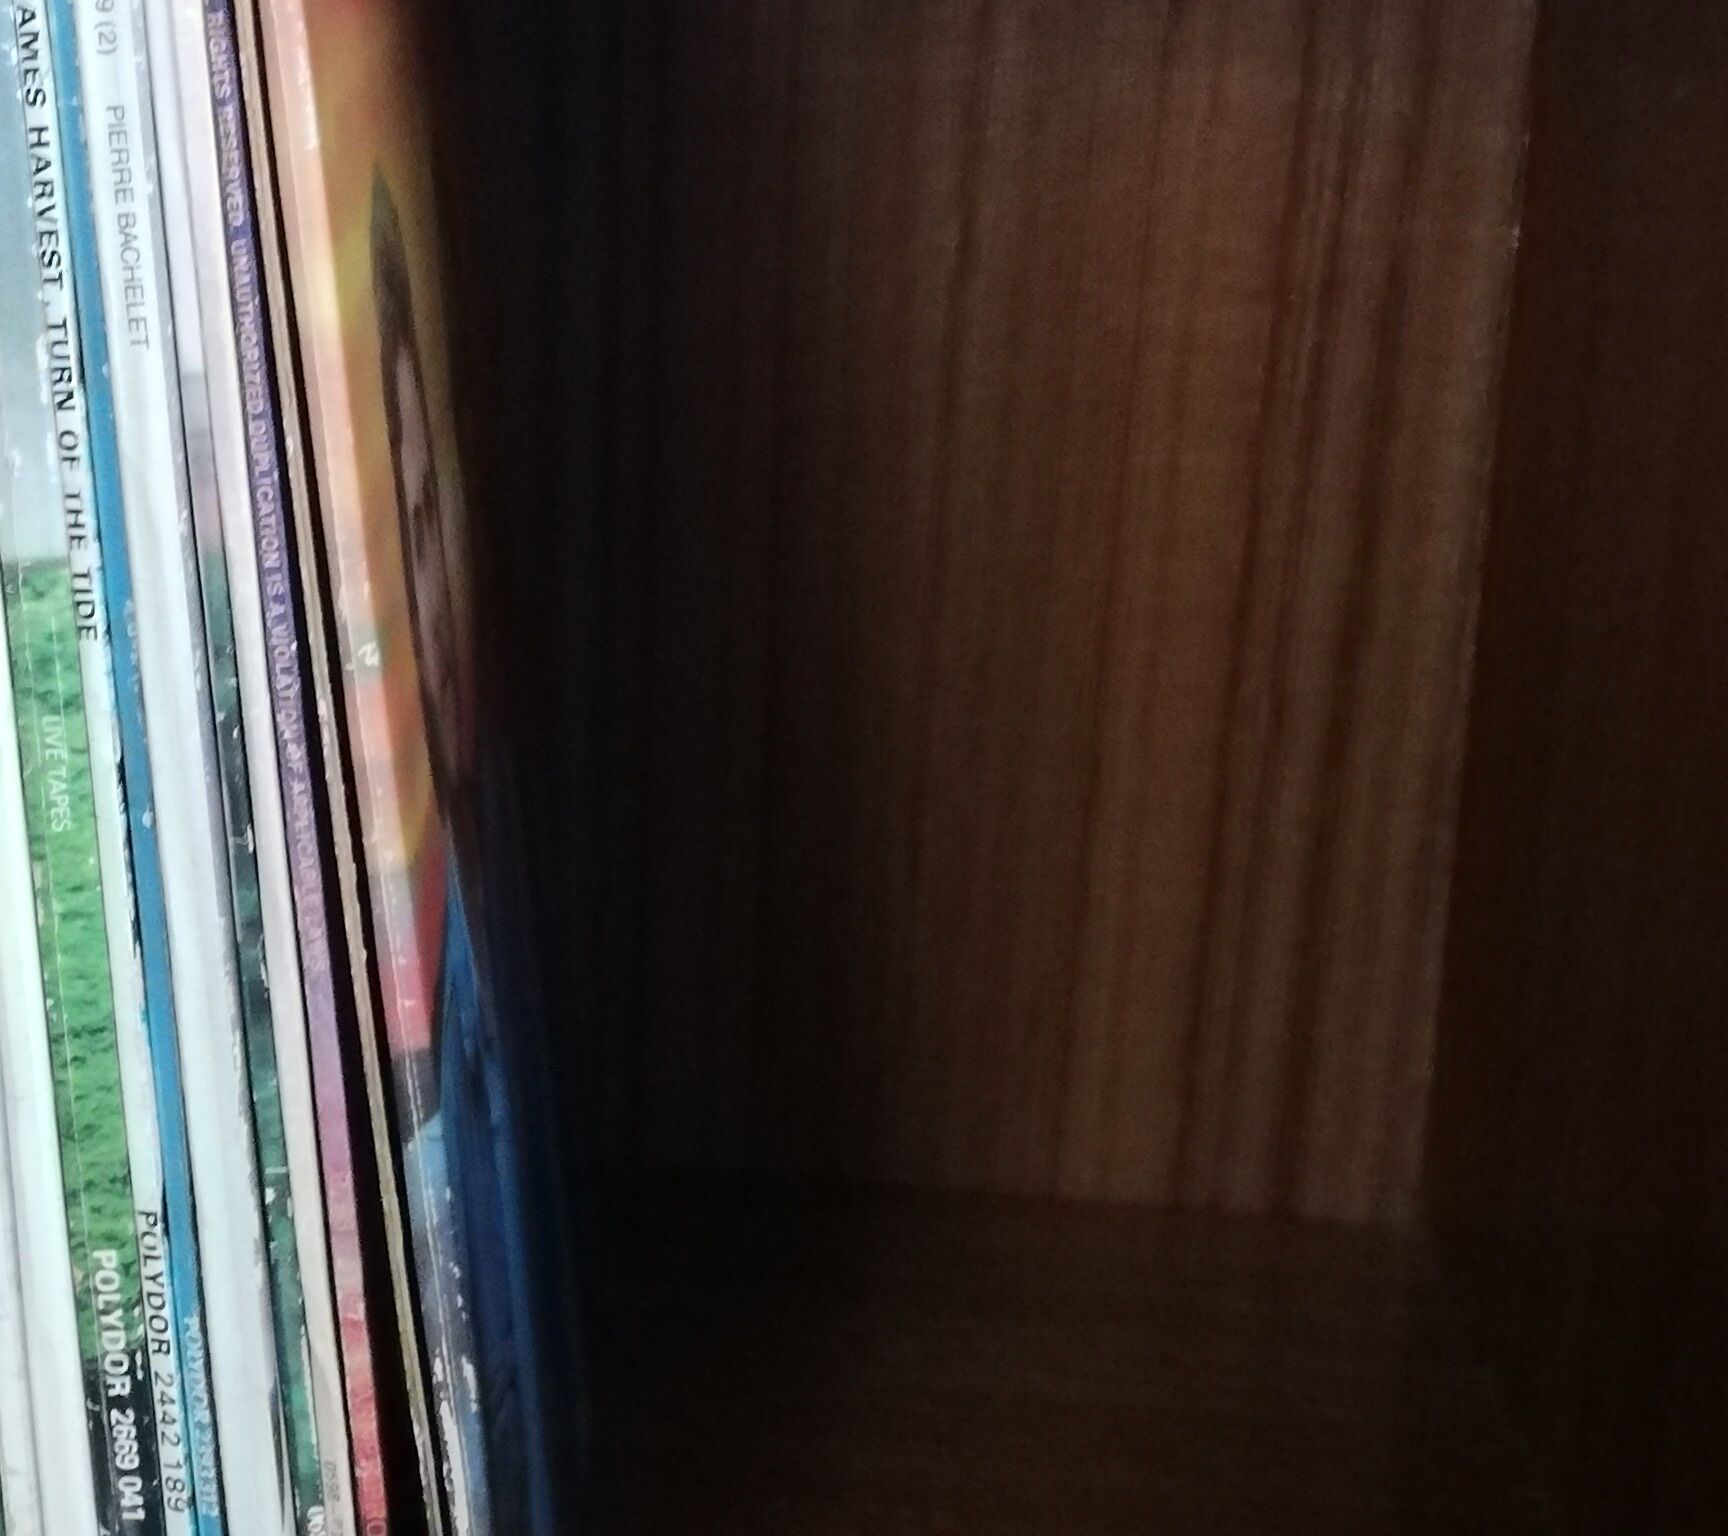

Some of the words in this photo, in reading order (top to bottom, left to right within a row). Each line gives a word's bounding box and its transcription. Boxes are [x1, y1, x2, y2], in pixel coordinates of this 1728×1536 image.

[91, 20, 119, 57] (2)
[102, 103, 136, 205] PIERRE
[113, 211, 152, 350] BACHELET
[203, 10, 235, 100] RIGHTS
[264, 573, 285, 598] IS
[43, 317, 76, 410] TURN
[55, 429, 83, 473] OF
[61, 491, 89, 552] THE
[69, 566, 99, 642] TIDE
[38, 713, 65, 761] LIVE
[43, 765, 73, 833] TAPES
[133, 1209, 173, 1357] POLYDOR
[89, 1248, 133, 1397] POLYDOR
[107, 1407, 141, 1471] 2669
[150, 1369, 182, 1448] 2442
[114, 1475, 146, 1522] 041
[160, 1459, 189, 1514] 189
